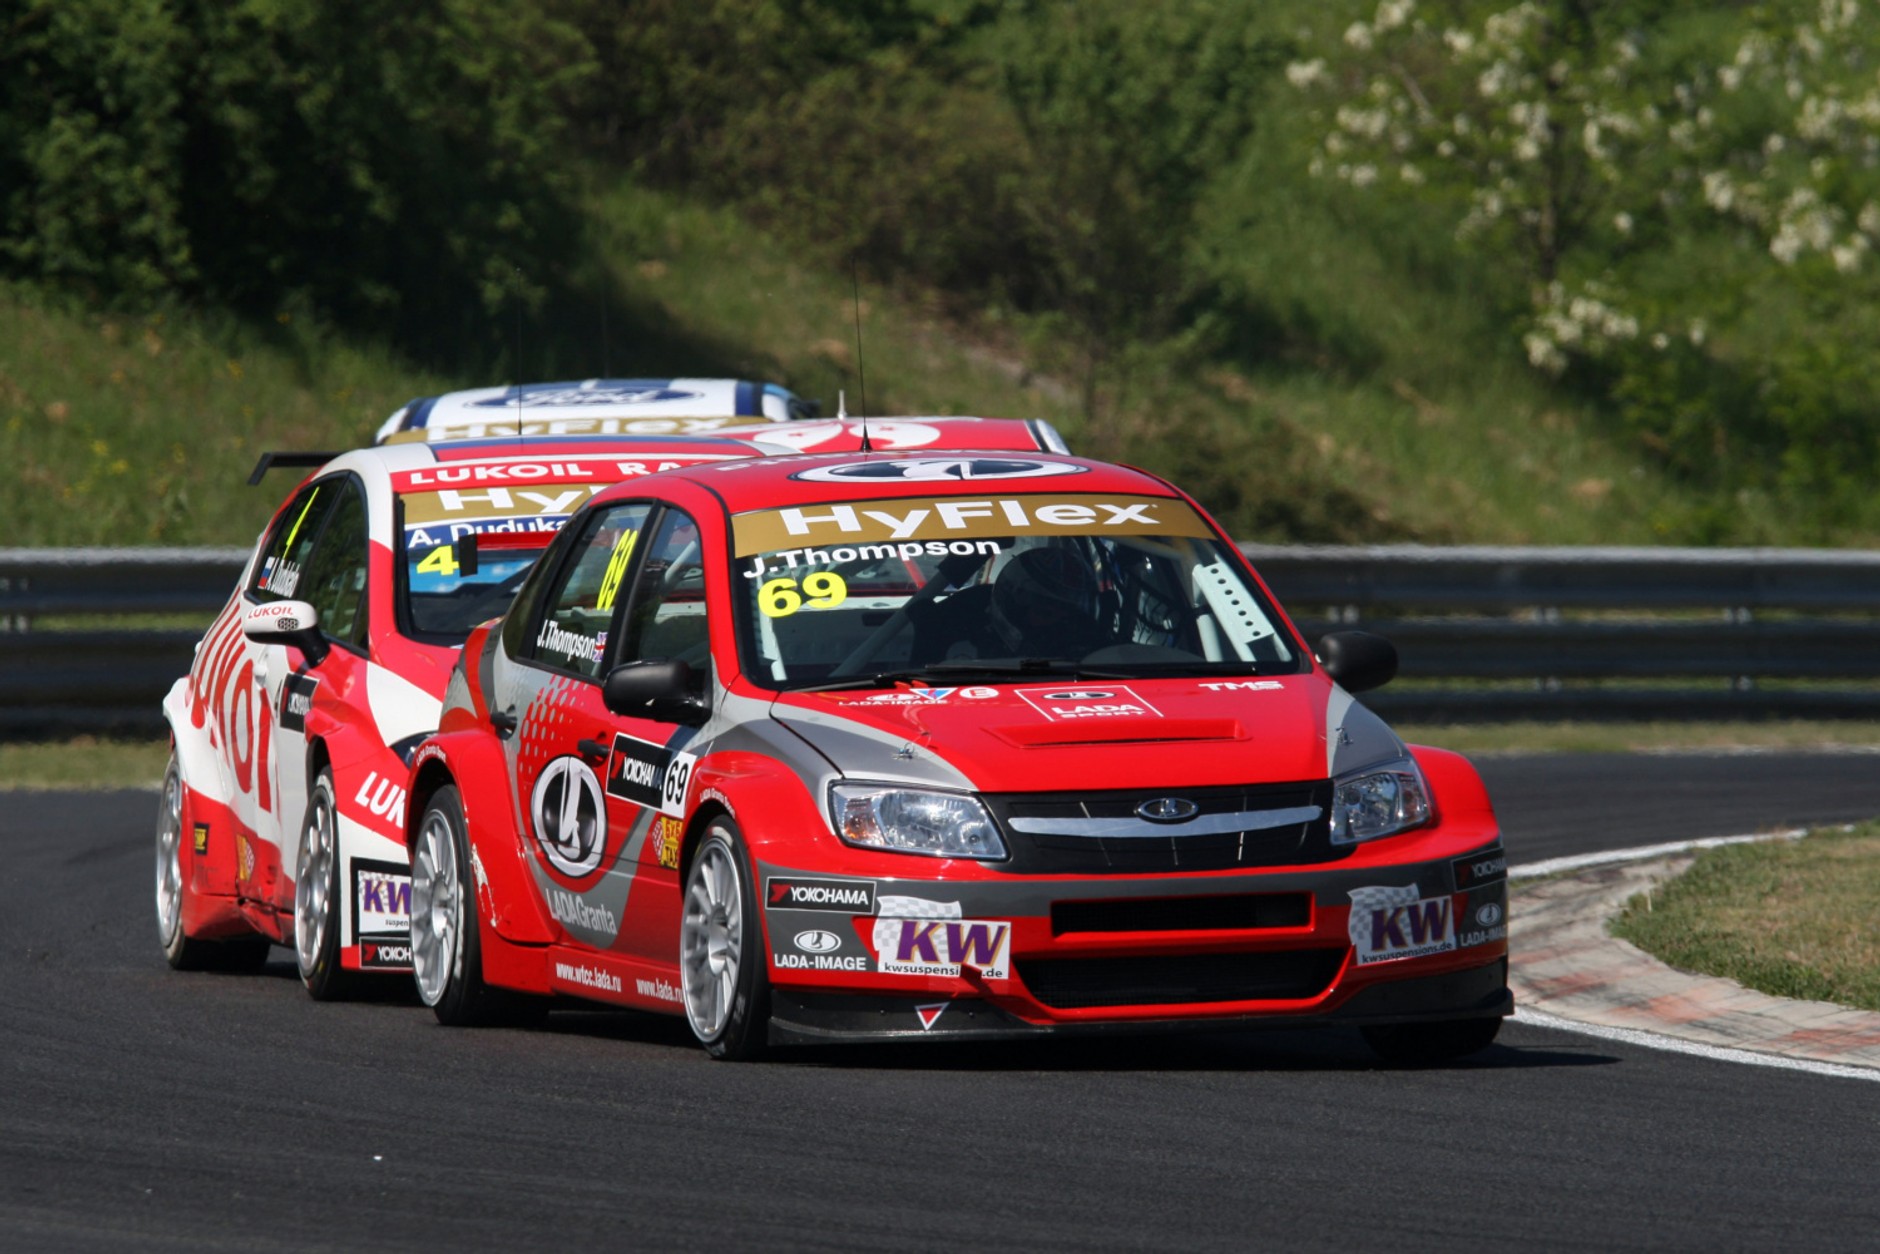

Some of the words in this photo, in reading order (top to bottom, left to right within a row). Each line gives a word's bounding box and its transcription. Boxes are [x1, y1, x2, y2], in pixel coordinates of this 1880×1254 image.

[427, 418, 727, 440] HyFlex
[410, 462, 593, 484] LUKOIL
[618, 461, 697, 475] RA
[437, 485, 618, 513] Hy
[780, 500, 1160, 538] HyFlex
[408, 529, 441, 549] A.
[416, 545, 460, 575] 4
[743, 537, 1000, 579] J.Thompson
[757, 572, 847, 618] 69
[248, 606, 294, 618] LUKOIL
[1051, 704, 1144, 714] LADA
[666, 760, 689, 805] 69
[791, 886, 869, 905] YOKOHAMA
[1371, 899, 1450, 951] KW
[896, 920, 1008, 967] KW
[774, 953, 867, 971] LADA-IMAGE
[884, 962, 1003, 978] kwsuspensi.de
